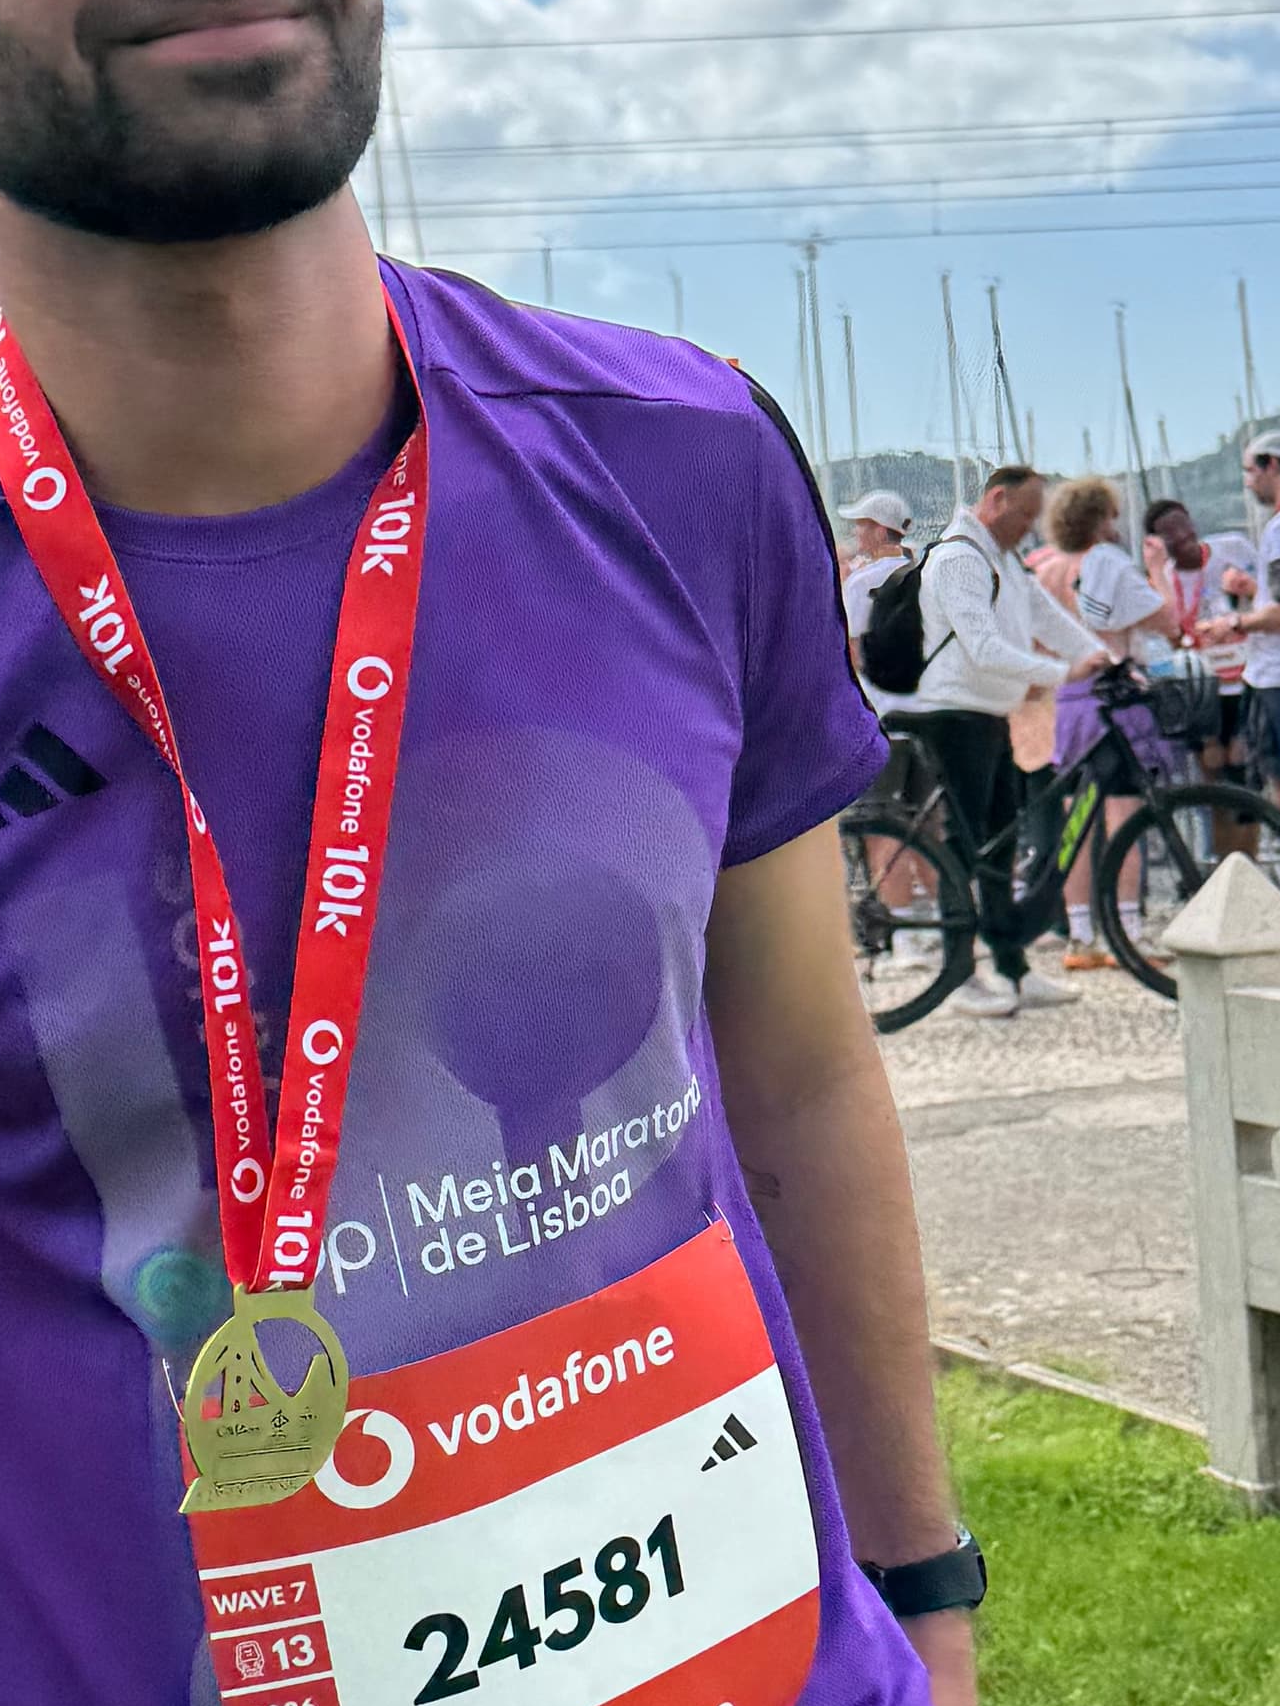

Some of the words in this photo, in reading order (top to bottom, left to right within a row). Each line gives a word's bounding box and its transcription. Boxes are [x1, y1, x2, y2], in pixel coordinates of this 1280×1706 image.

[340, 708, 375, 834] vodafone
[224, 1020, 251, 1152] vodafone
[289, 1072, 325, 1201] vodafone
[406, 1160, 541, 1228] Meia
[420, 1227, 487, 1275] de
[494, 1168, 632, 1256] Lisboa
[427, 1325, 675, 1456] vodafone
[211, 1584, 286, 1615] WAVE
[290, 1580, 307, 1603] 7
[271, 1634, 316, 1670] 13
[403, 1513, 685, 1706] 24581
